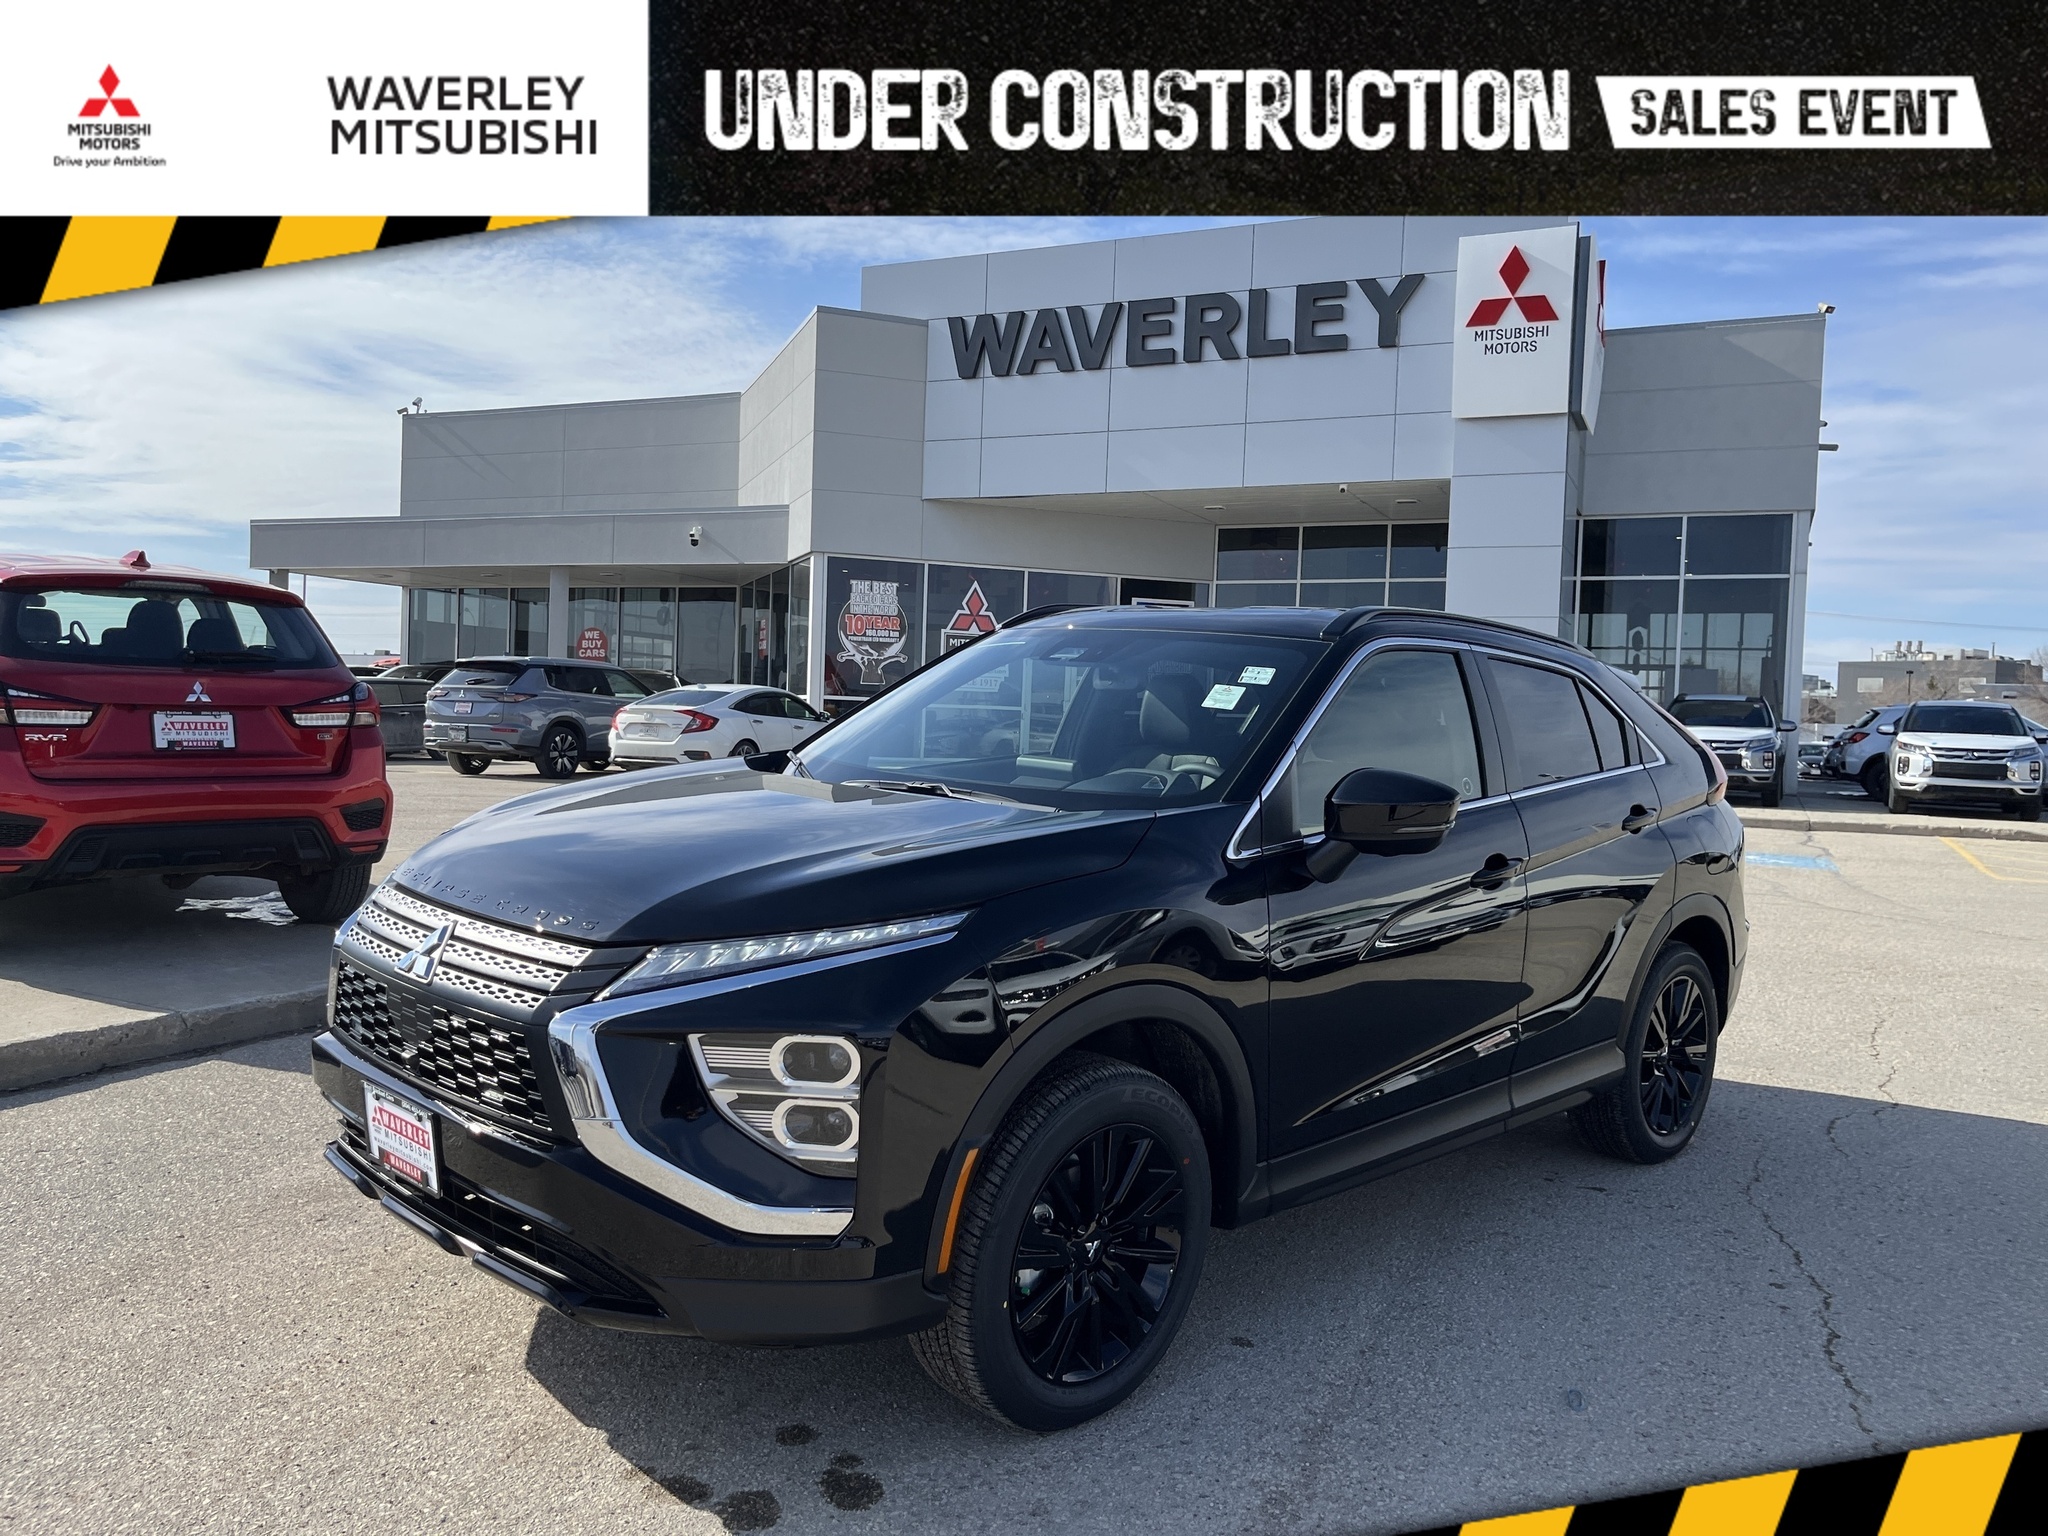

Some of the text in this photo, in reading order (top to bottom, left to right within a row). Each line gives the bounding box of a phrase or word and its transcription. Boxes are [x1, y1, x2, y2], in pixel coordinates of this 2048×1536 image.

[947, 273, 1426, 380] WAVERLEY
[1474, 325, 1549, 342] MITSUBISHI
[1484, 341, 1538, 355] MOTORS
[850, 579, 899, 596] THE BEST
[851, 593, 898, 605] BACKED CARS
[851, 604, 898, 616] IN THE WORLD
[845, 614, 900, 636] 10 YEAR
[584, 631, 600, 639] WE
[581, 640, 603, 648] BUY
[579, 649, 606, 657] CARS
[174, 722, 228, 731] WAVERLEY
[24, 733, 68, 741] RVR
[401, 867, 600, 931] ECLIPSE CROSS
[381, 1110, 430, 1149] WAVERLEY
[384, 1129, 432, 1162] MITSUBISHI
[389, 1154, 422, 1181] WAVERLEY
